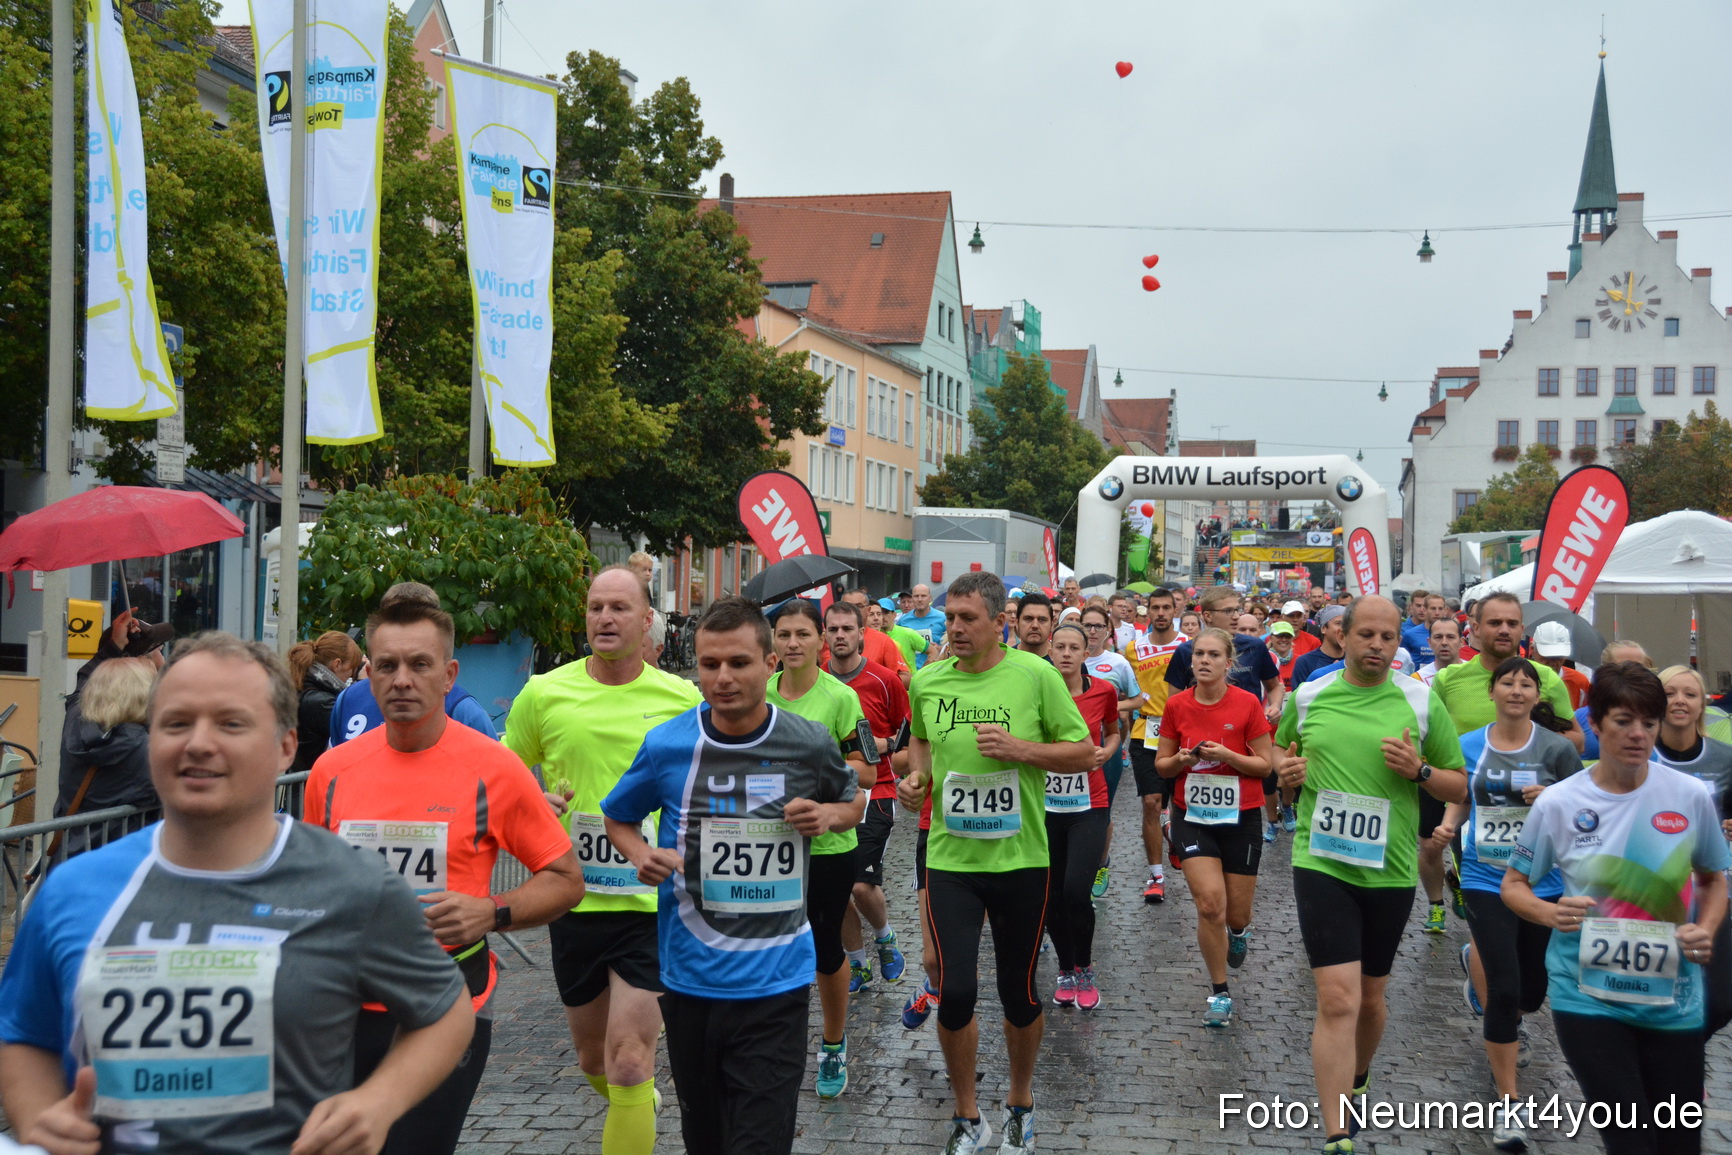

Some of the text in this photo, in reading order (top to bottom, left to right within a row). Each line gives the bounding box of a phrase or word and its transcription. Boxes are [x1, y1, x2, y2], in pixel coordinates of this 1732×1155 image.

[1132, 465, 1327, 490] BMW Laufsport
[1271, 550, 1295, 560] ZIEL
[1540, 486, 1617, 610] REWE
[1138, 660, 1161, 672] MAX
[1045, 774, 1085, 794] 2374
[951, 787, 1014, 814] 2149
[1049, 798, 1079, 806] Veronika
[1190, 785, 1235, 806] 2599
[437, 805, 457, 813] asics
[1202, 809, 1219, 819] Anja
[384, 824, 438, 838] BOCK
[747, 822, 796, 834] BOCK
[963, 819, 1003, 830] Michael
[1319, 806, 1382, 841] 3100
[1483, 820, 1524, 843] 223
[709, 828, 742, 836] NeuerMarkt
[711, 841, 796, 877] 2579
[1493, 848, 1511, 858] Stef
[730, 886, 776, 899] Michal
[1625, 922, 1667, 935] BOCK
[168, 950, 259, 969] BOCK
[1590, 938, 1669, 974] 2467
[100, 964, 158, 975] NeuerMarkt
[1604, 974, 1650, 993] Monika
[102, 986, 255, 1050] 2252
[134, 1067, 213, 1093] Daniel
